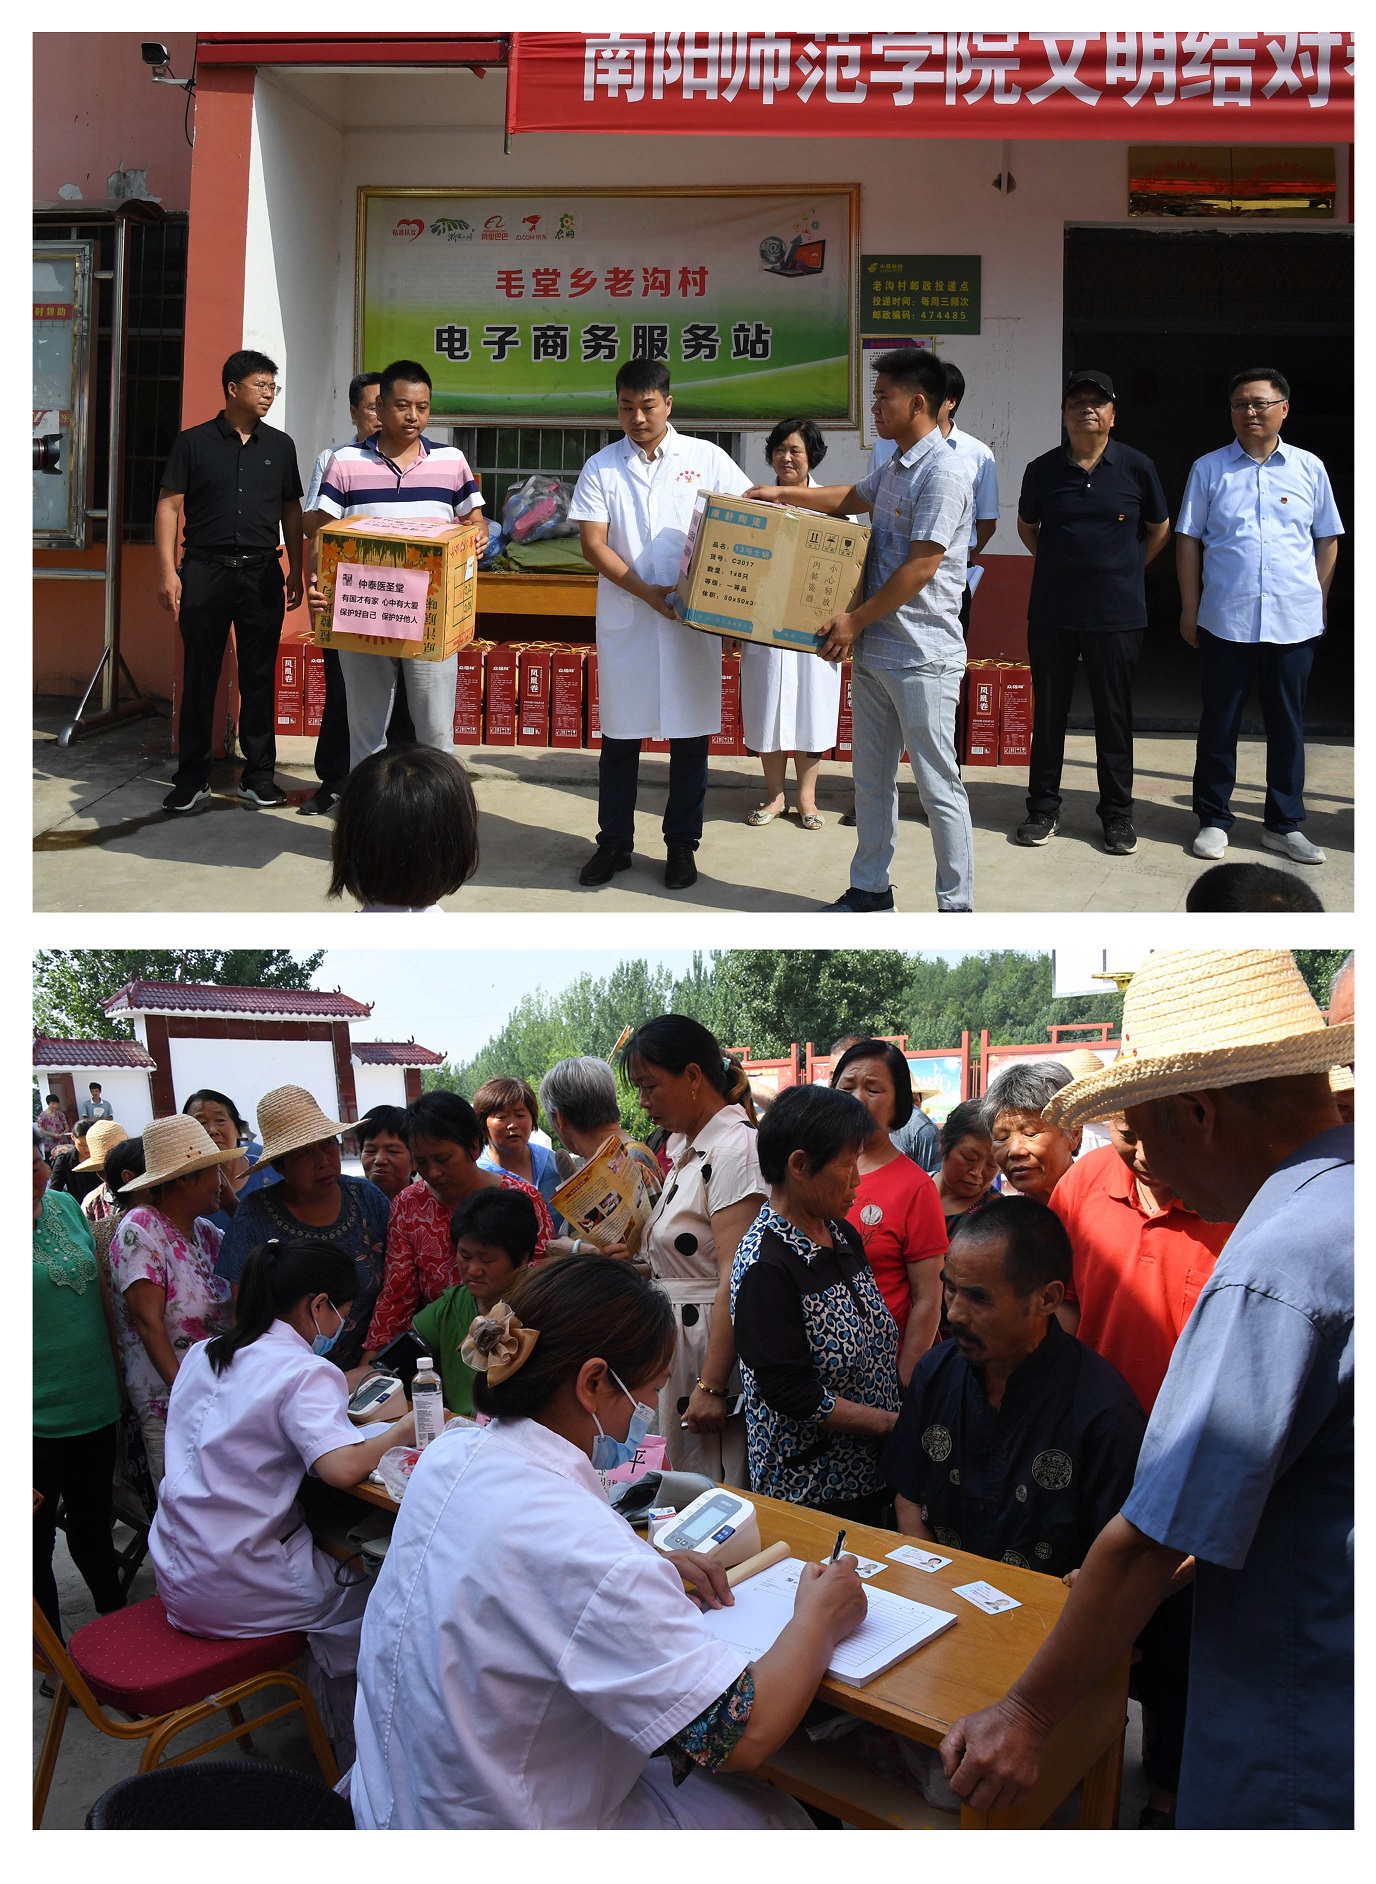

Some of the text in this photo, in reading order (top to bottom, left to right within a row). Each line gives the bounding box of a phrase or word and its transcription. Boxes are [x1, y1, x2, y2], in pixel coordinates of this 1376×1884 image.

[583, 32, 1353, 107] 南阳师范学院文明结对
[481, 233, 509, 241] 阿里巴巴
[495, 265, 709, 298] 毛堂乡老沟村
[872, 280, 969, 291] 老沟村邮政投递点
[872, 297, 969, 306] 投递时间： 每周三频次
[872, 310, 966, 320] 邮政编码： 474485
[434, 322, 773, 361] 电子商务服务站
[734, 544, 771, 560] 13号土锅
[731, 557, 755, 567] C2017
[358, 579, 405, 594] 仲泰医圣堂
[726, 583, 747, 593] 一等品
[805, 560, 821, 603] 内装瓷器
[821, 563, 838, 607] 小心轻放
[341, 594, 419, 610] 有国才有家 心中有大爱
[723, 594, 756, 606] 50x50x3
[339, 608, 418, 624] 保护好自己 保护好他人
